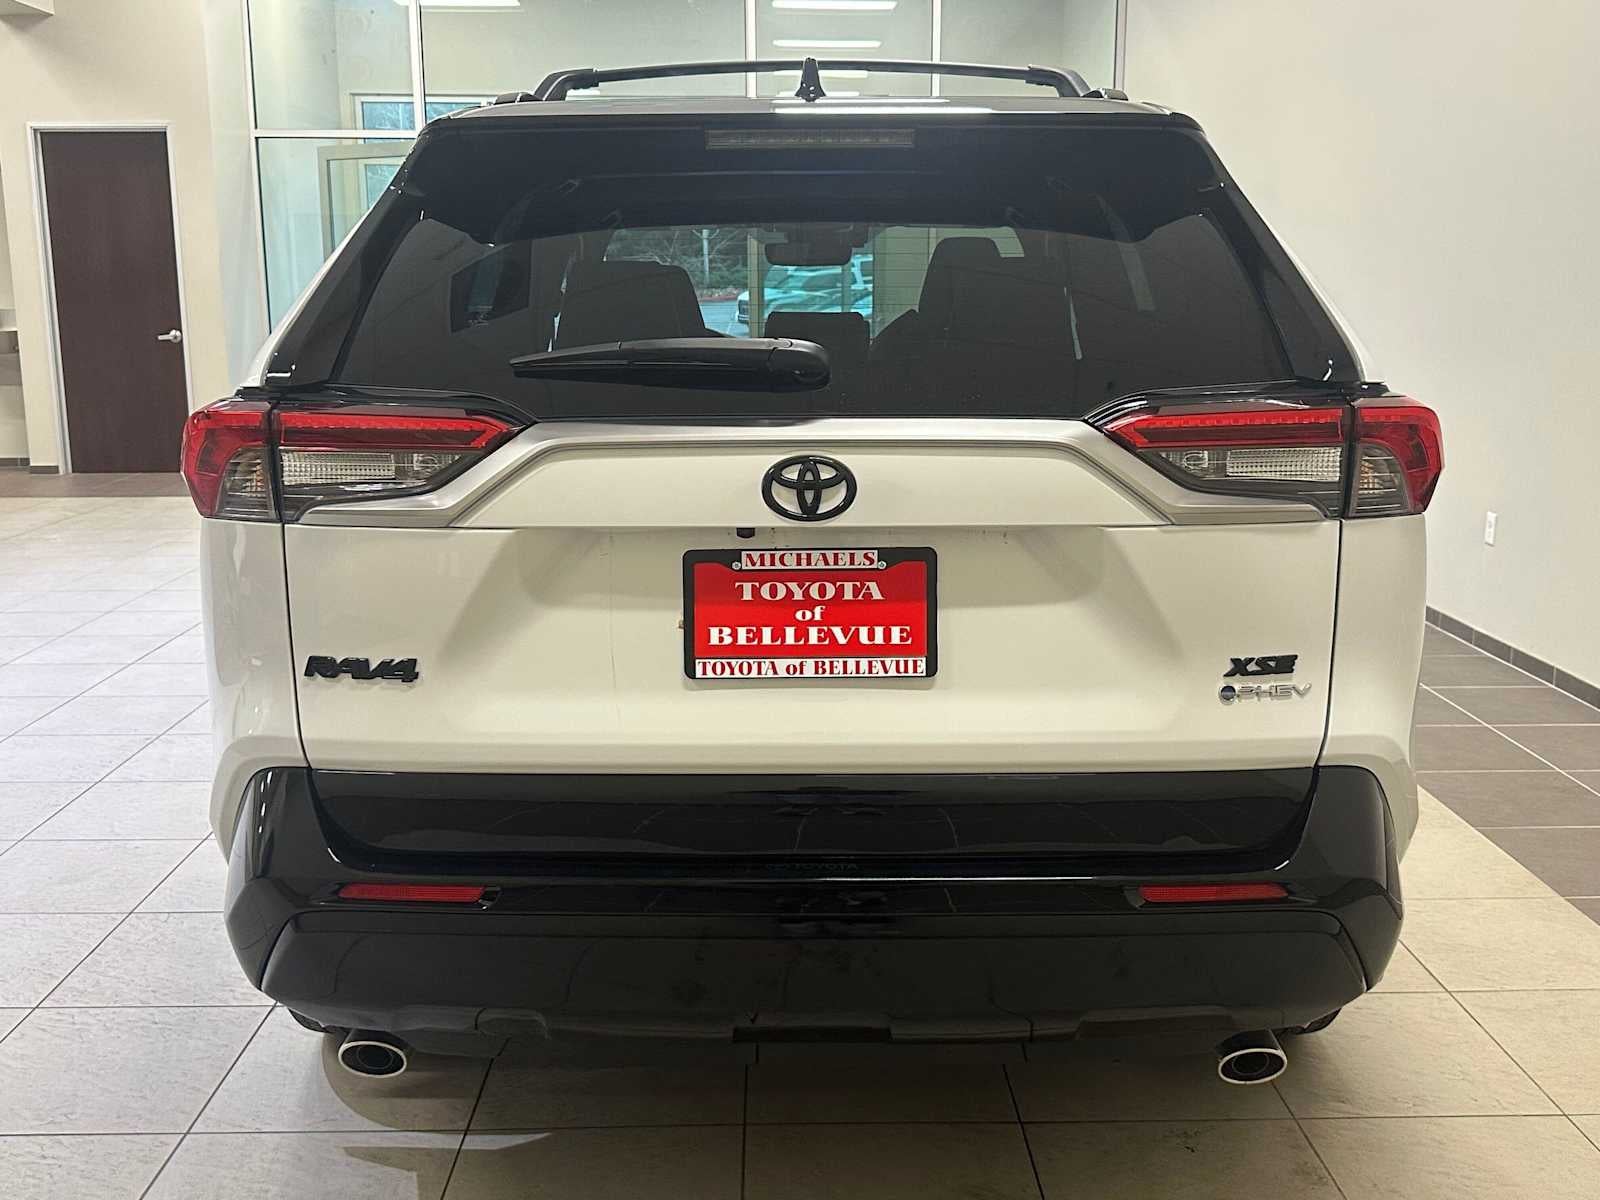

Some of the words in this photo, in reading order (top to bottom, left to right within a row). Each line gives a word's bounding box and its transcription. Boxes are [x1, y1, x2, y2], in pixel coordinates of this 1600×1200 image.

[745, 551, 876, 568] MICHAELS
[735, 581, 885, 601] TOYOTA
[795, 605, 826, 621] of
[708, 626, 912, 646] BELLEVUE
[304, 655, 419, 682] RAV4
[698, 660, 778, 676] TOYOTA
[785, 660, 808, 676] of
[814, 659, 925, 676] BELLEVUE
[1223, 654, 1298, 677] XSE
